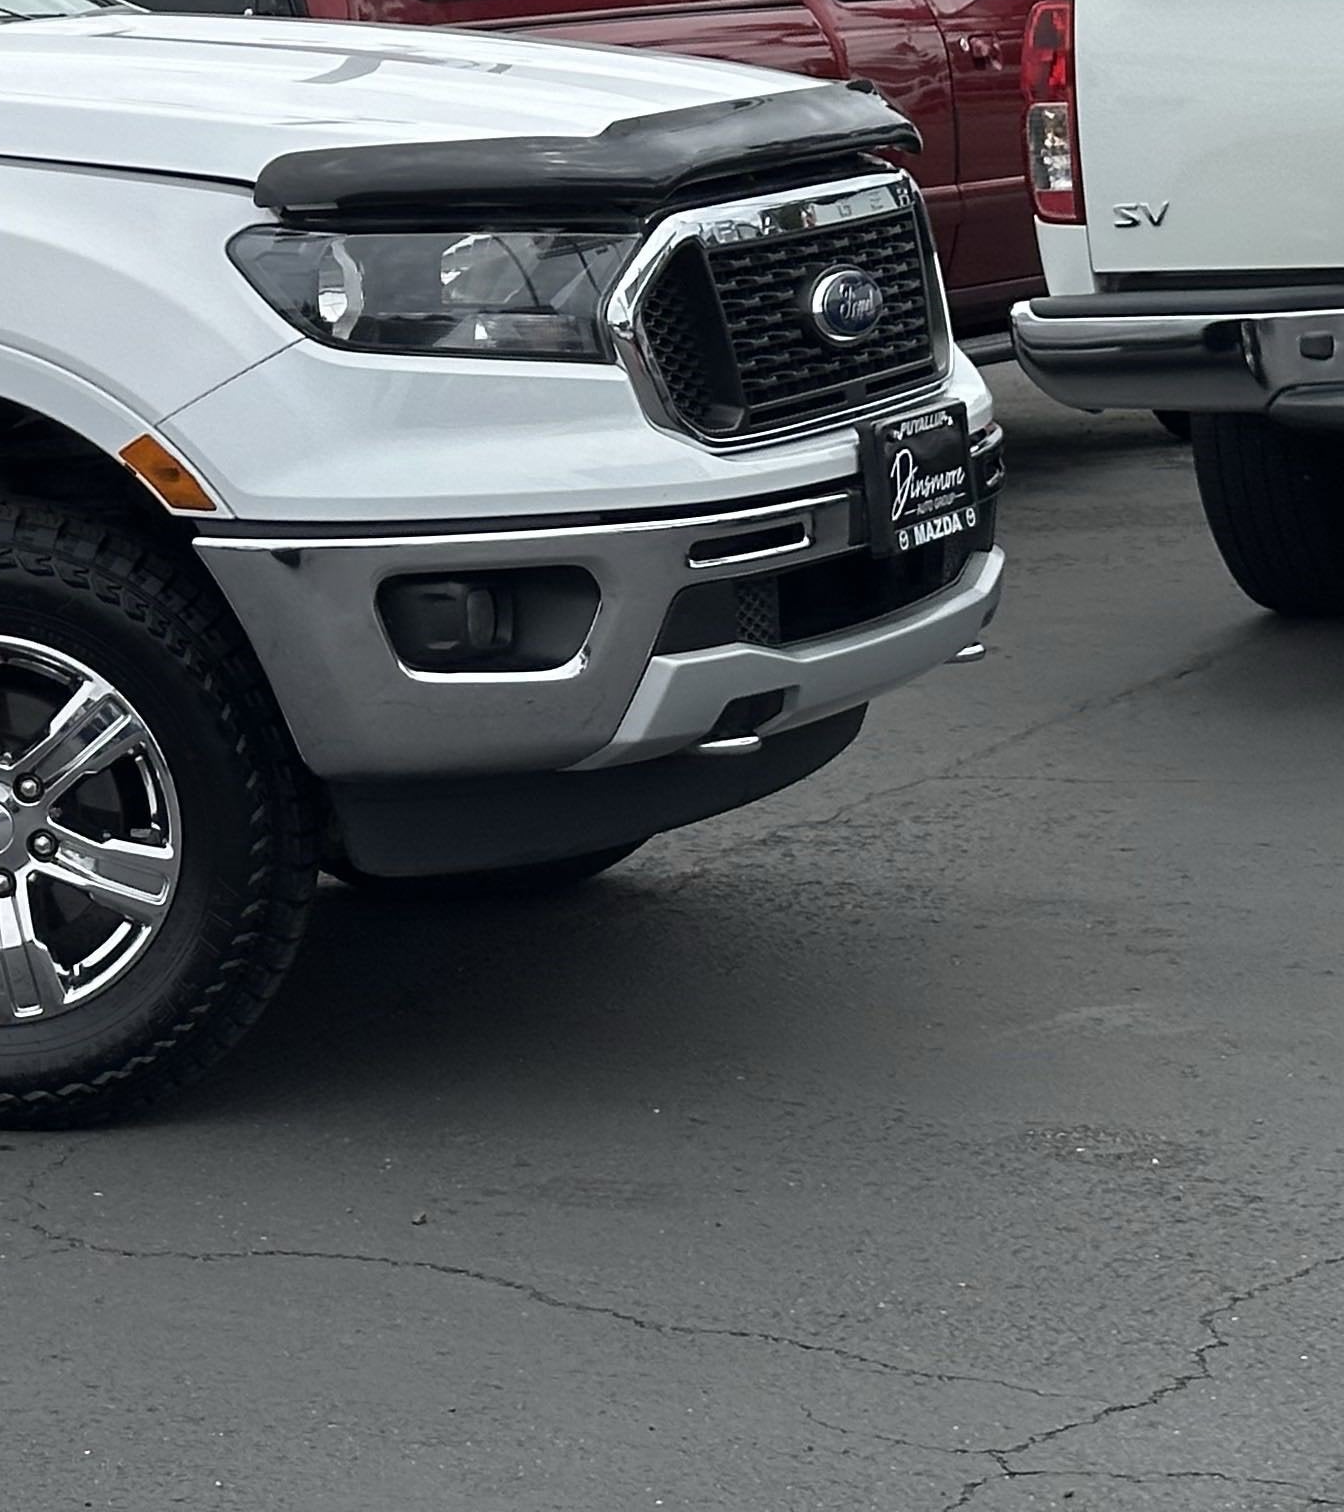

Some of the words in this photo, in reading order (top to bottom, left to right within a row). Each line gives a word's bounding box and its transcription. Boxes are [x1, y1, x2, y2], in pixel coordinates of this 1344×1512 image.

[1113, 201, 1170, 229] SV
[891, 449, 965, 521] Dinsmore
[914, 513, 962, 545] MAZDA
